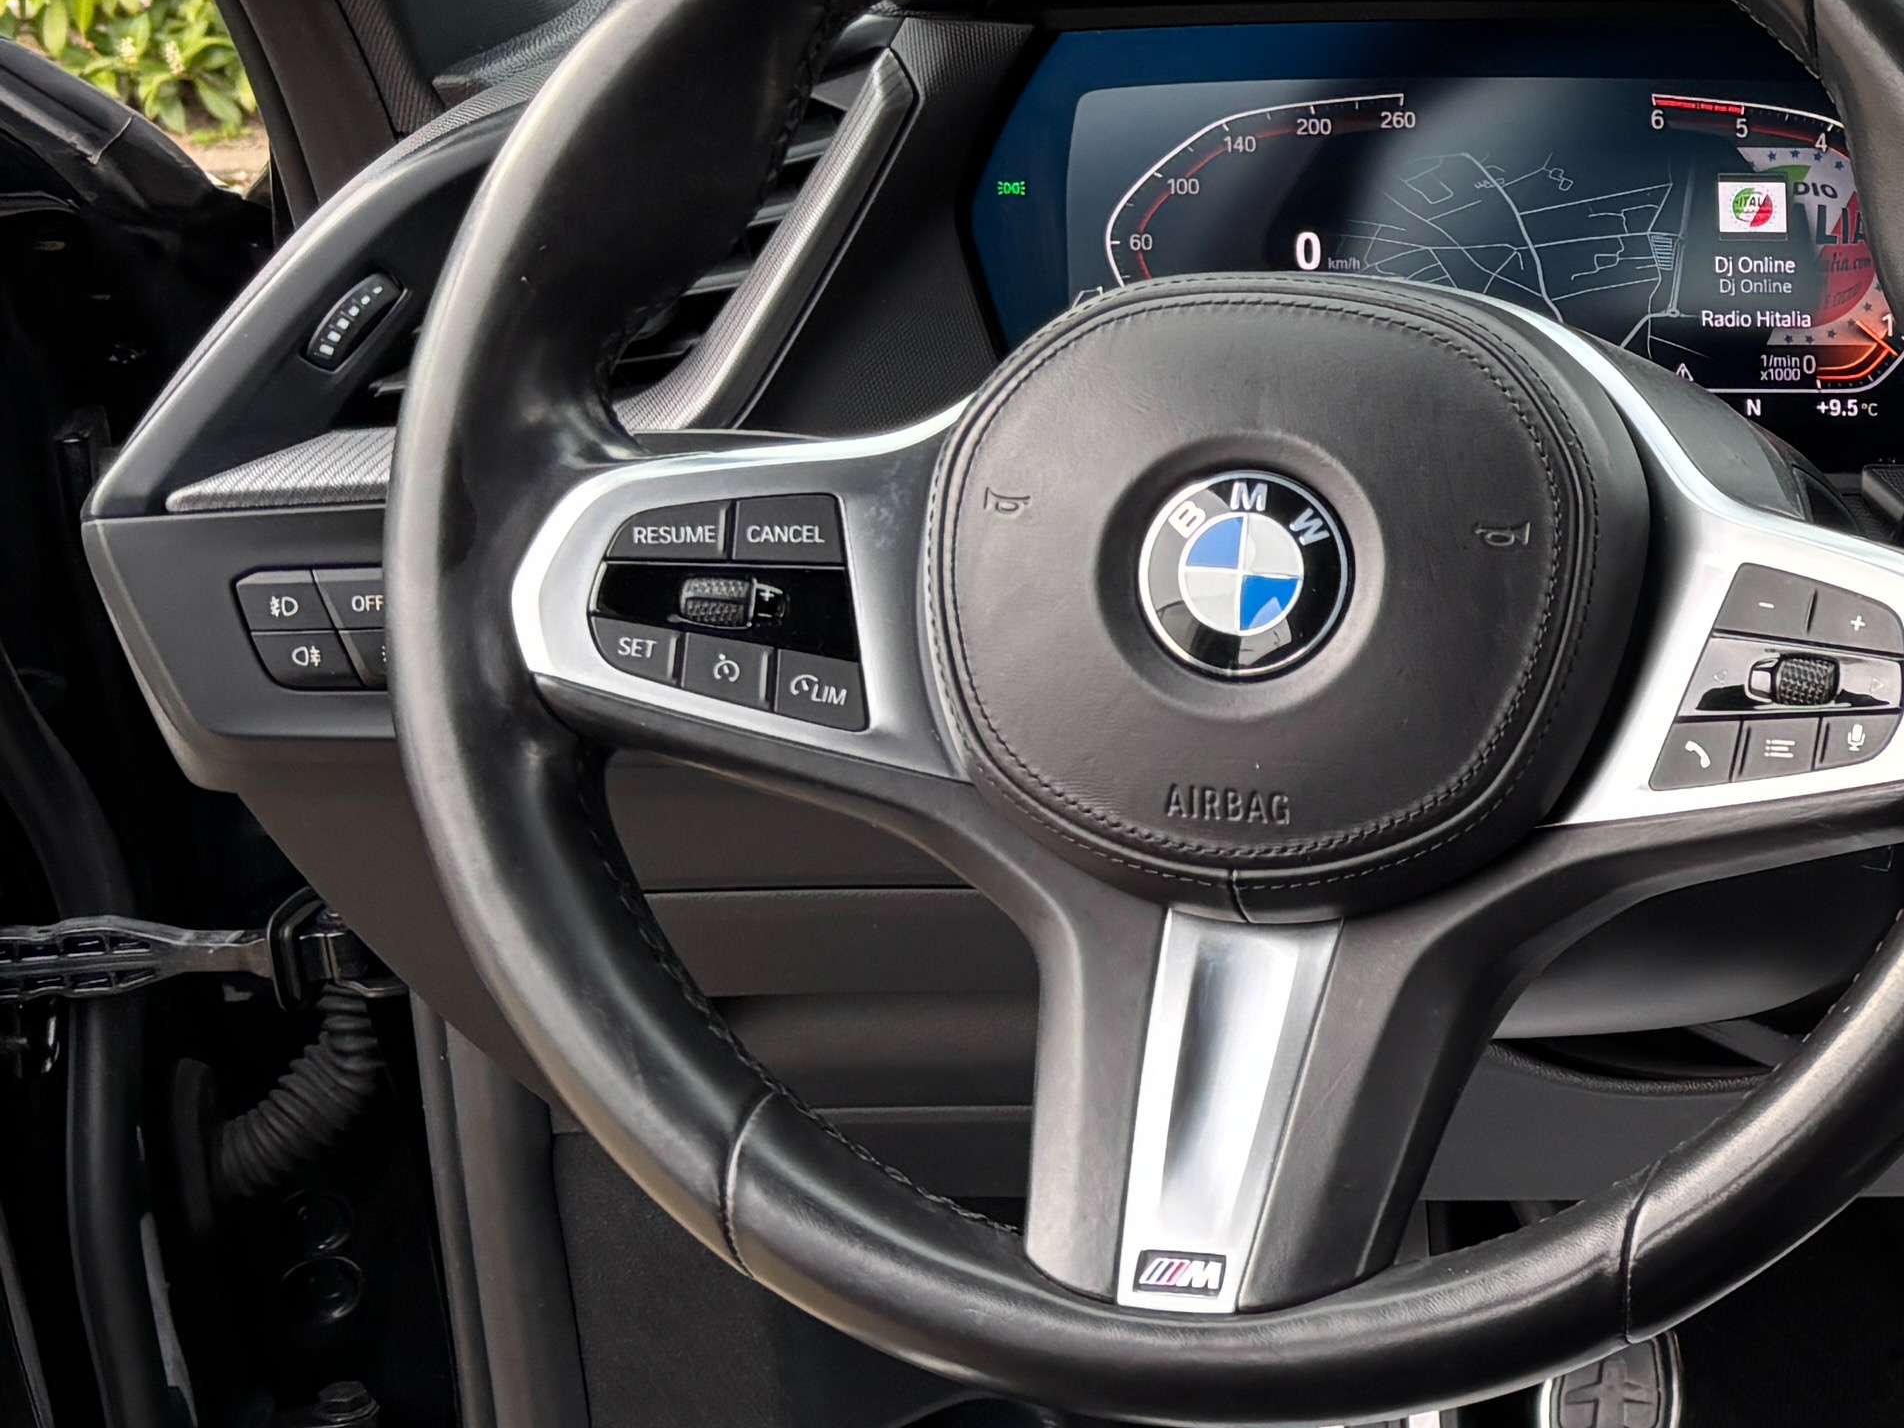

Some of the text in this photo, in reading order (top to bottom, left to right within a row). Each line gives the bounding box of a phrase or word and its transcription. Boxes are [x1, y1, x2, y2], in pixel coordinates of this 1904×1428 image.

[1296, 118, 1332, 136] 200
[1380, 111, 1416, 129] 260
[1651, 109, 1665, 130] 6
[1735, 118, 1749, 138] 5
[1224, 135, 1256, 153] 140
[1814, 132, 1828, 153] 4
[1167, 178, 1200, 196] 100
[1129, 233, 1153, 252] 60
[1295, 230, 1361, 271] 0 km/h
[1714, 256, 1796, 277] Dj Online
[1719, 278, 1793, 296] Dj Online
[1700, 310, 1812, 328] Radio Hitalia
[1883, 313, 1894, 337] 1
[1760, 353, 1816, 374] 1/min 0
[1760, 368, 1800, 381] x1000
[1747, 399, 1762, 417] N
[1816, 399, 1859, 417] +9.5
[1168, 481, 1330, 546] BMW
[632, 526, 825, 544] RESUME CANCEL
[352, 595, 384, 613] OFF
[617, 637, 657, 660] SET
[811, 684, 848, 707] LIM
[1166, 783, 1291, 825] AIRBAG
